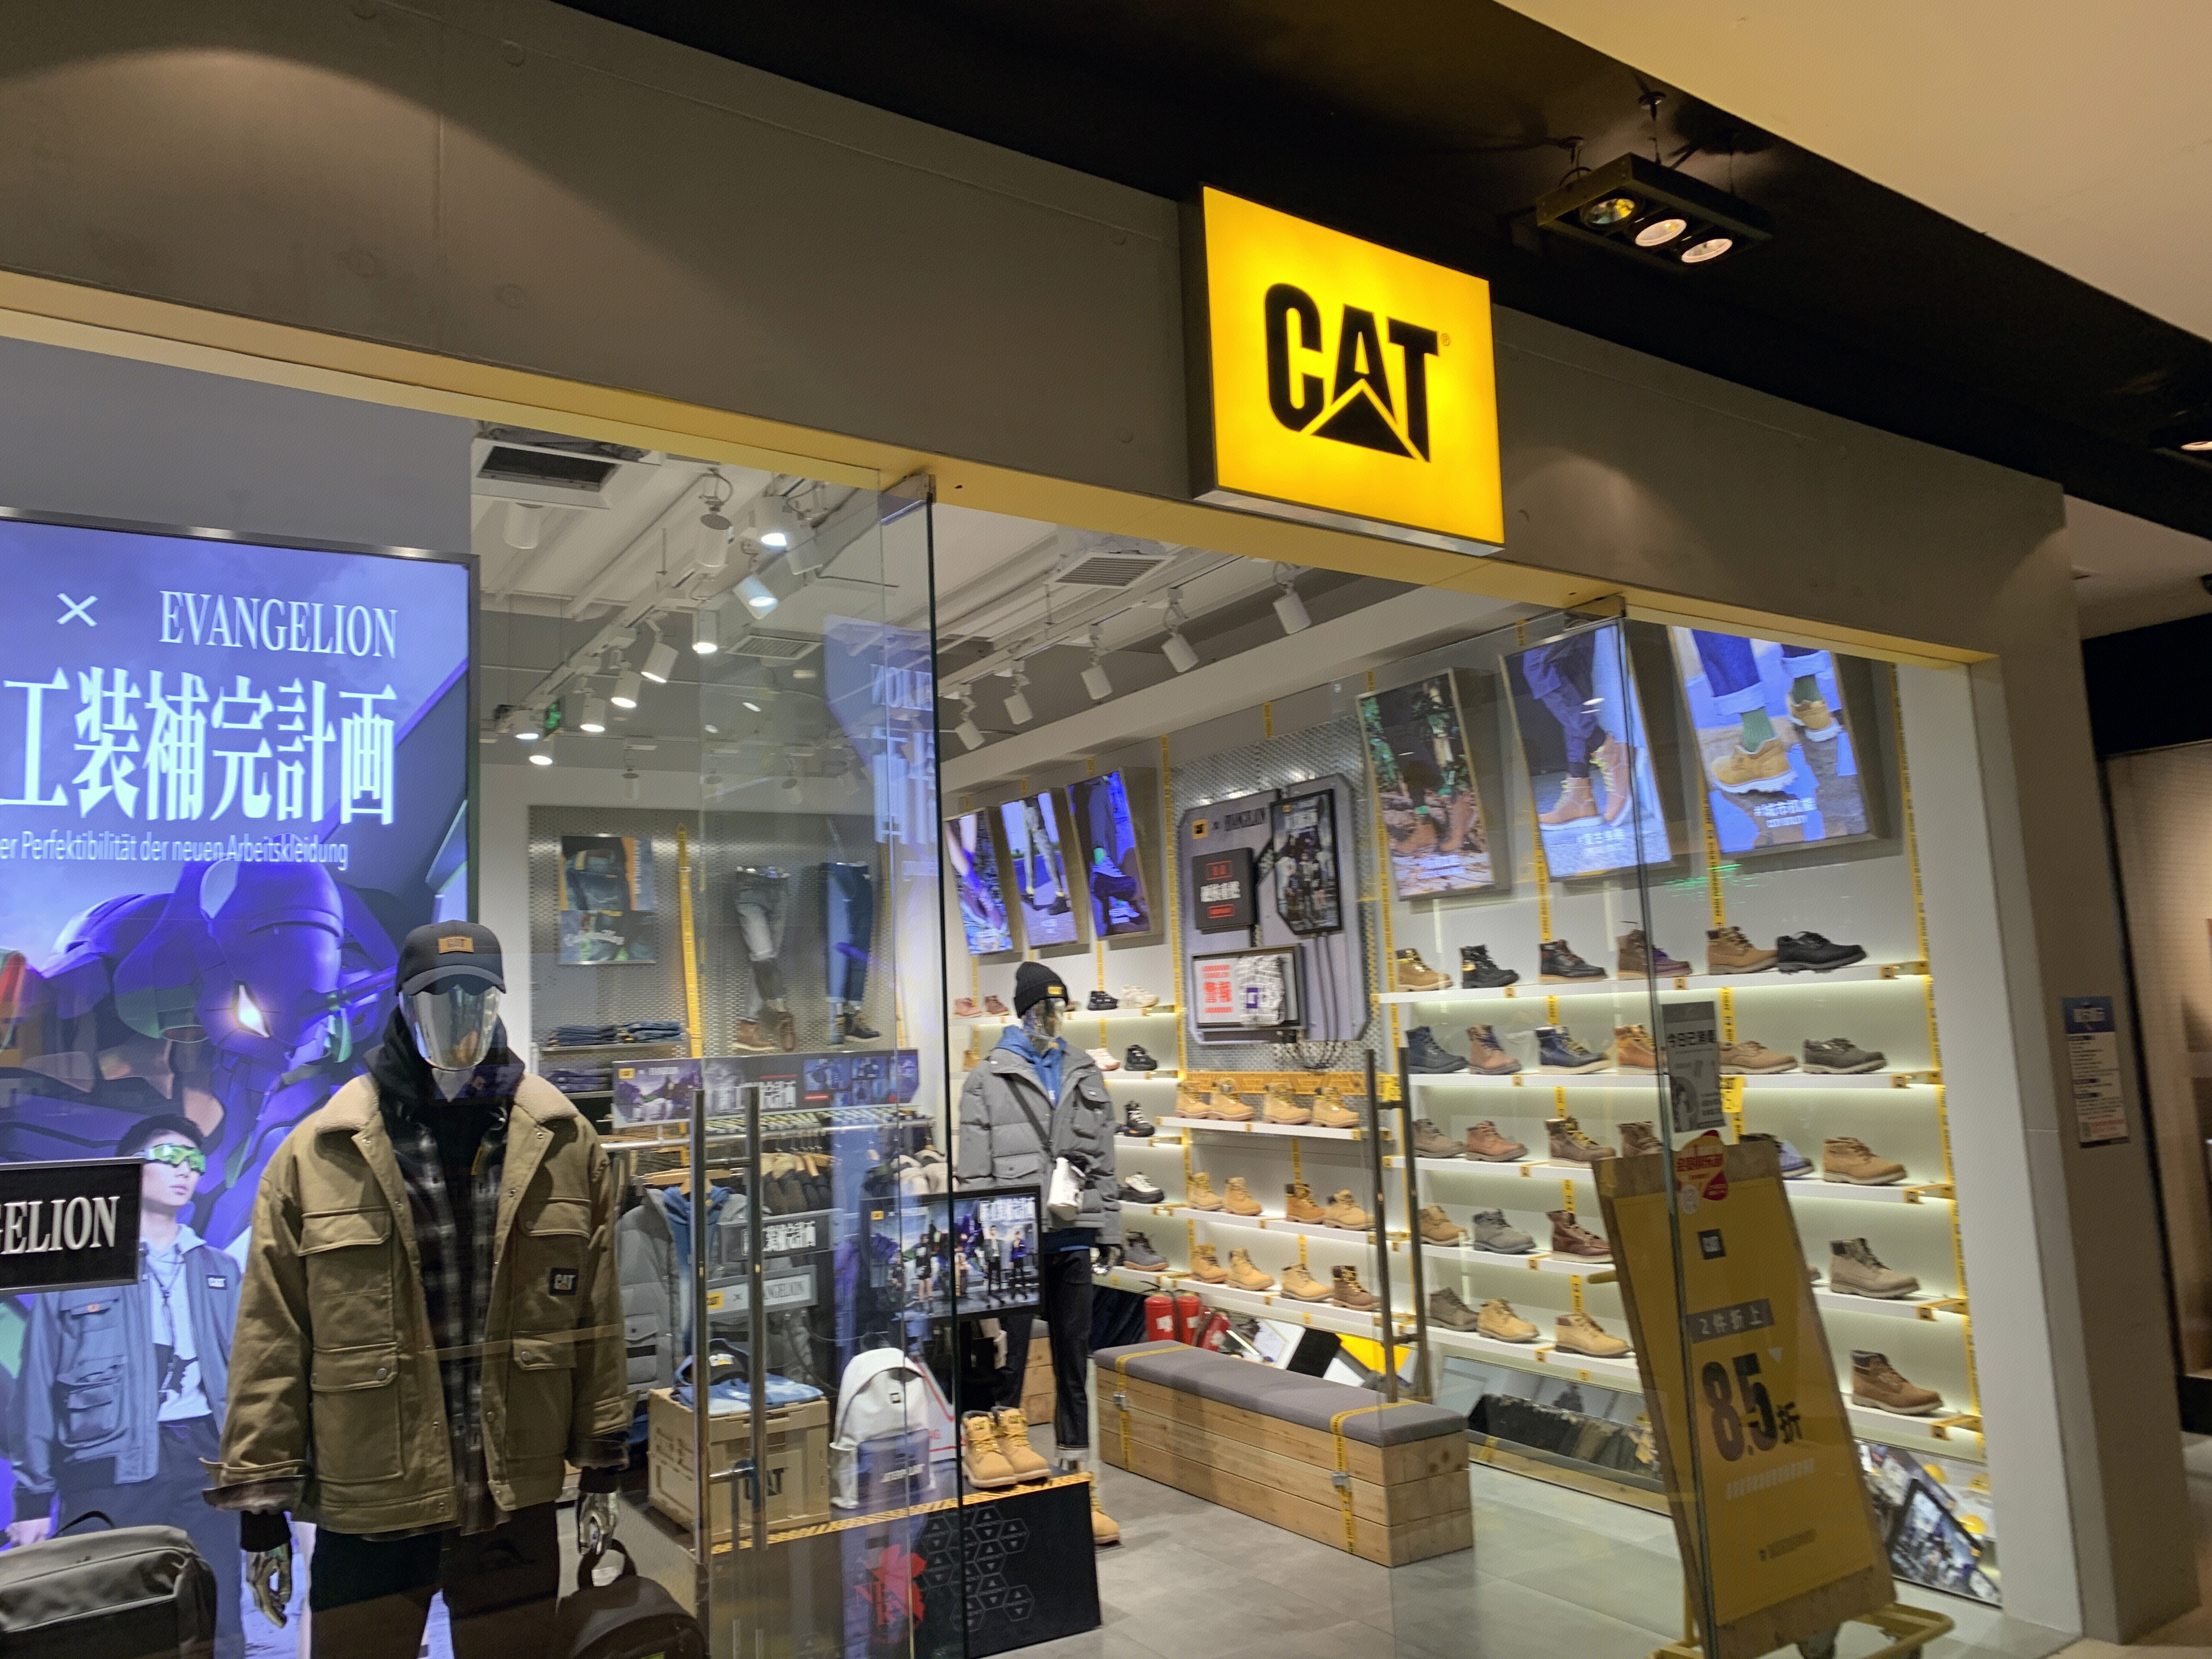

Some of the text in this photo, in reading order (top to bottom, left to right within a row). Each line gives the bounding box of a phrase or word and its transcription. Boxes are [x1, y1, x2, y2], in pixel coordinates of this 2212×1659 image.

[1264, 282, 1438, 463] CAT
[159, 590, 398, 658] EVANGELION
[0, 667, 397, 826] 工装補完計画
[21, 830, 137, 861] Perfektibilität
[139, 832, 169, 861] der
[172, 839, 224, 861] neuen
[228, 833, 349, 871] Arbeitskleidung
[0, 1196, 121, 1255] ELION
